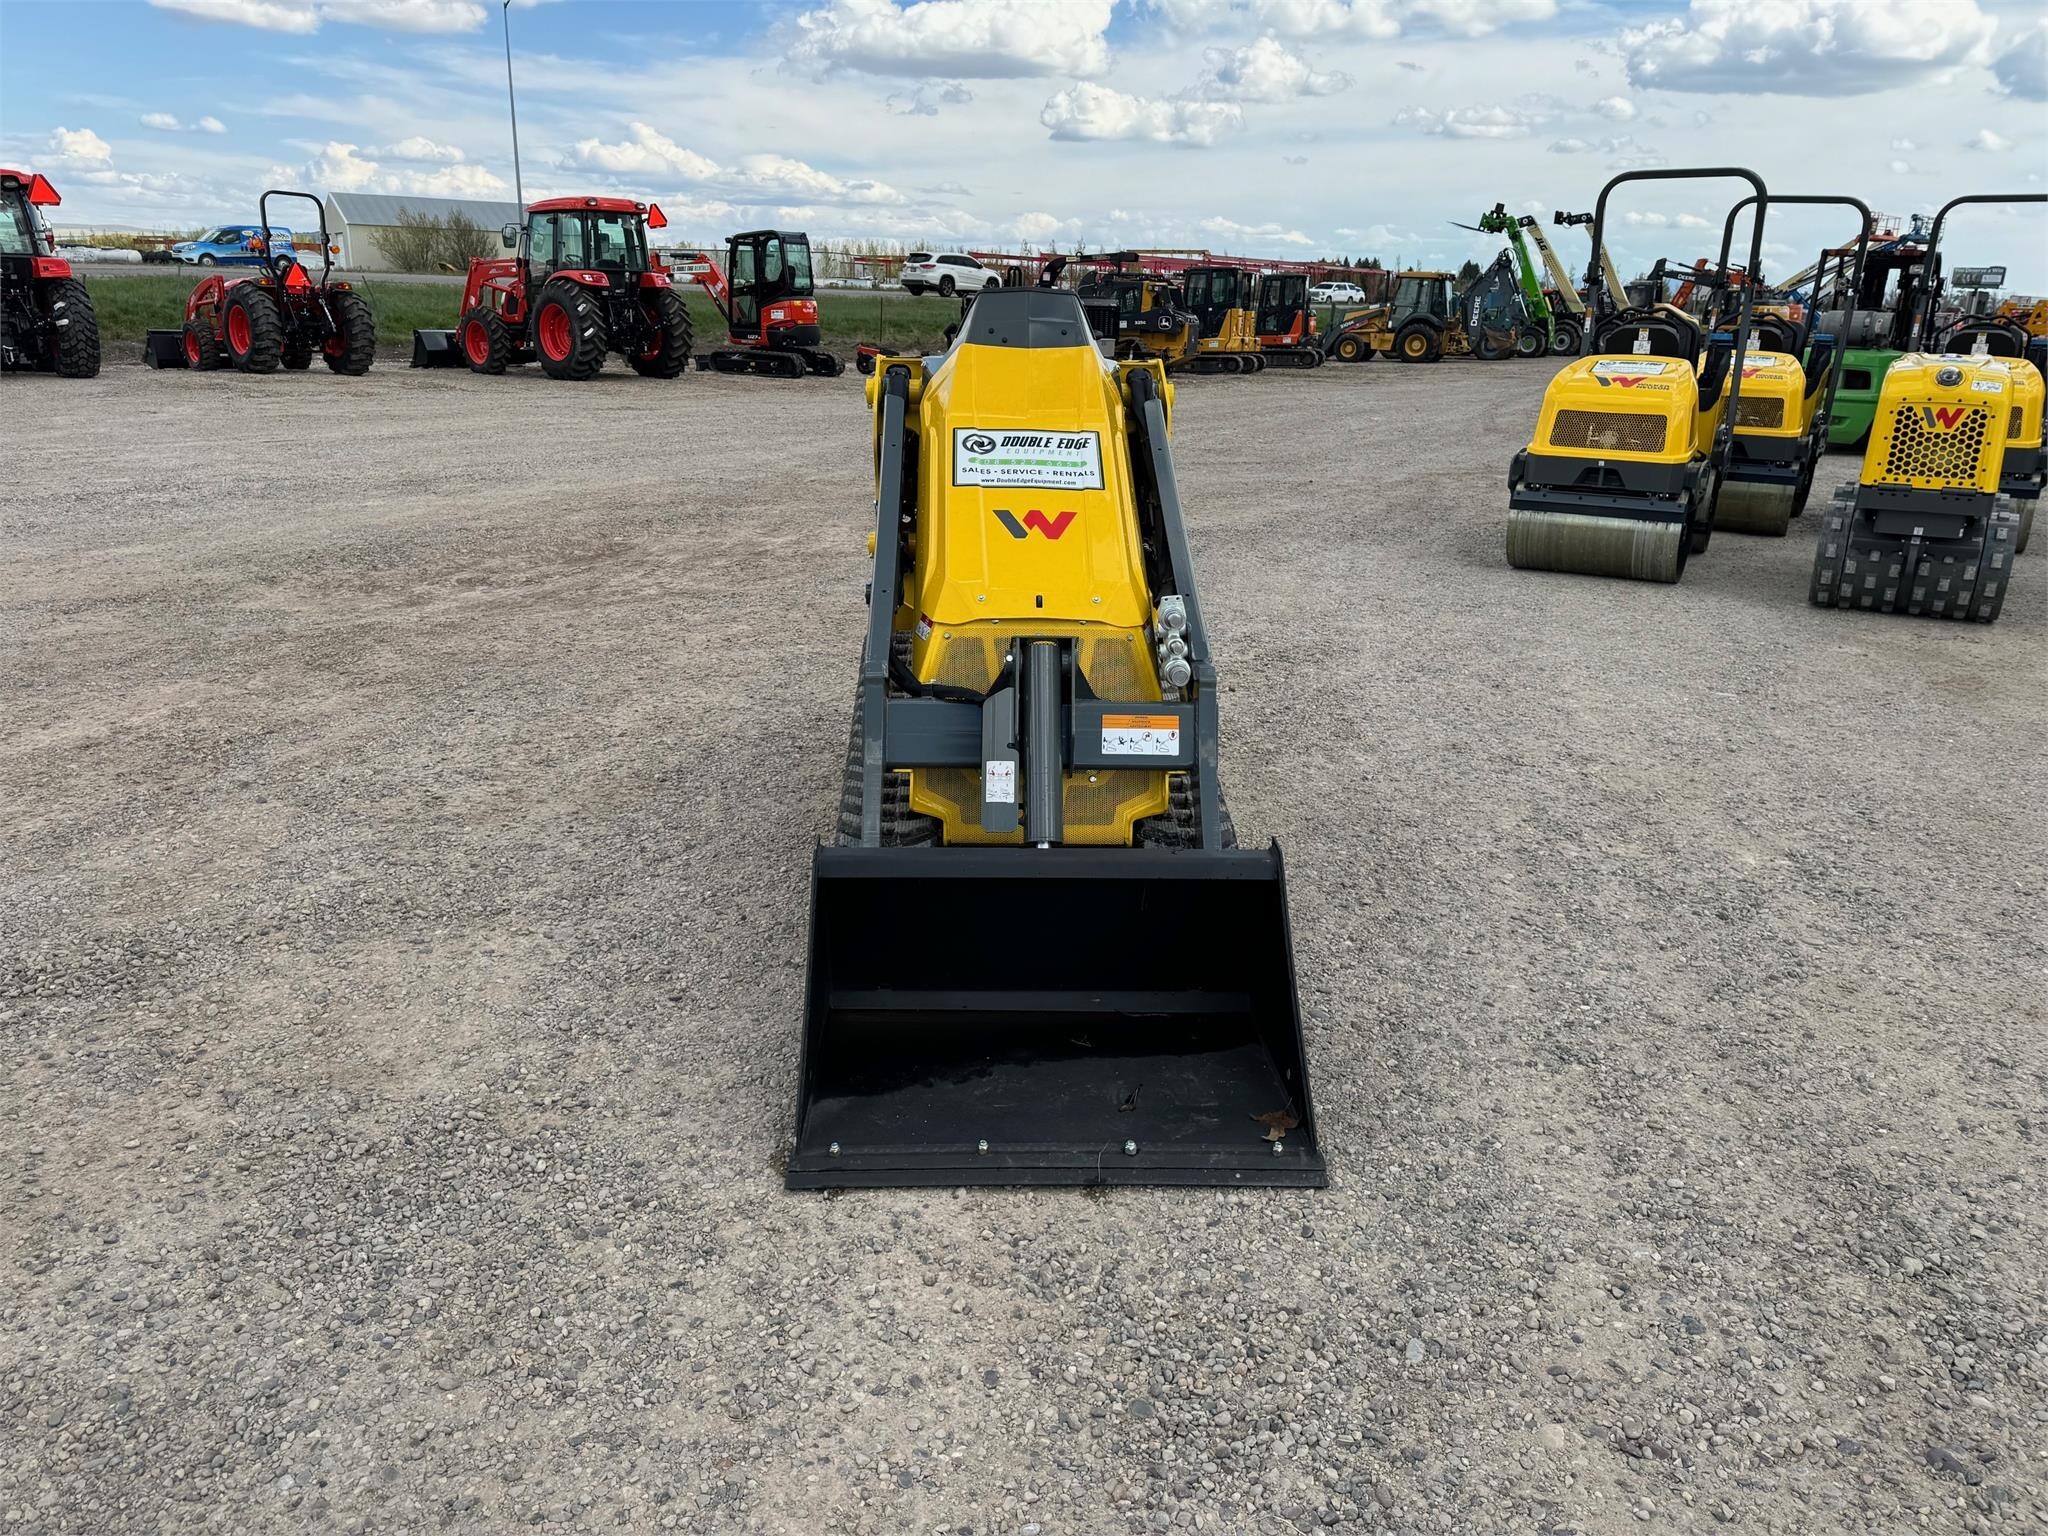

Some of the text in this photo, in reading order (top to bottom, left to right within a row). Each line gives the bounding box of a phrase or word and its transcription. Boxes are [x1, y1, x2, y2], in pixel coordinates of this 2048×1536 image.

[1535, 237, 1548, 251] JLG
[1470, 295, 1481, 327] DEERE
[1000, 436, 1092, 450] DOUBLE EDGE
[1006, 448, 1080, 456] EQUIPMENT
[962, 467, 992, 475] SALES
